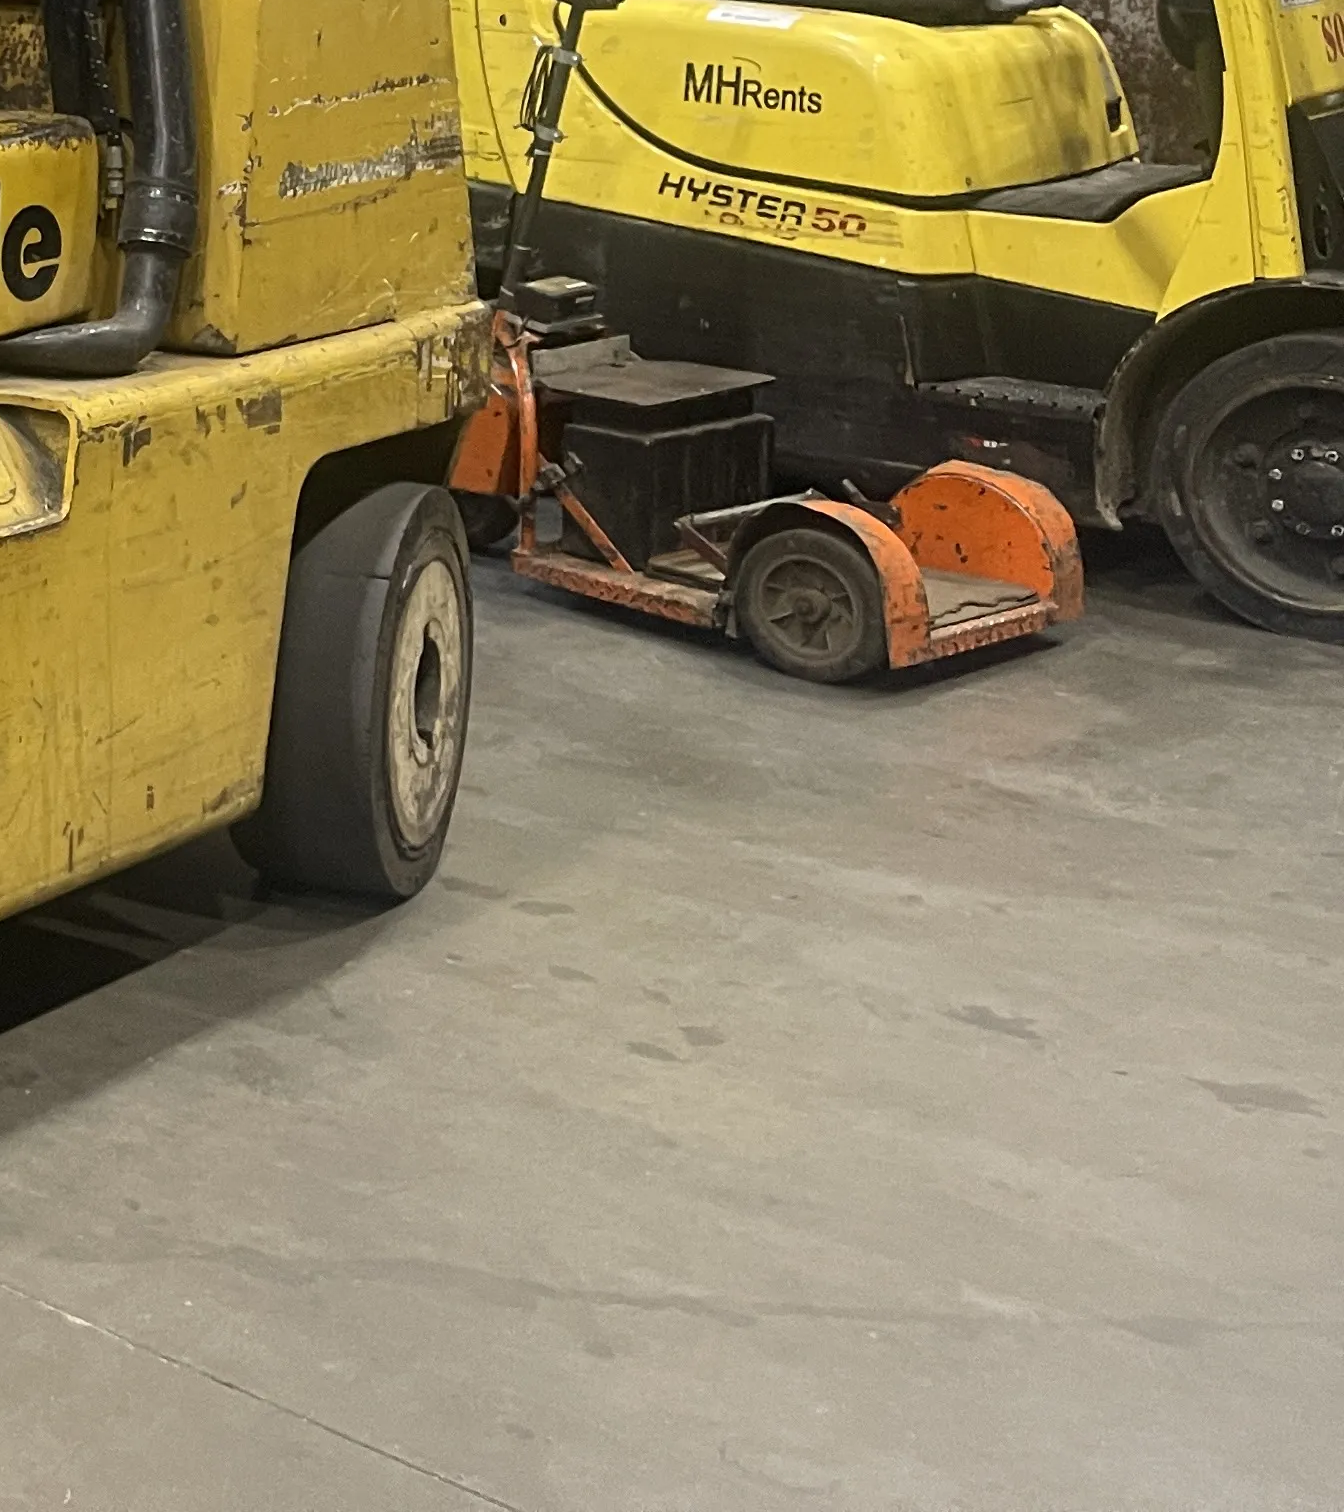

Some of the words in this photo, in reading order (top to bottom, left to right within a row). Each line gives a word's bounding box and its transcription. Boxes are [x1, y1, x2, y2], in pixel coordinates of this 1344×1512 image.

[683, 62, 823, 115] MHRents
[658, 172, 807, 227] HYSTER
[811, 206, 868, 238] 50
